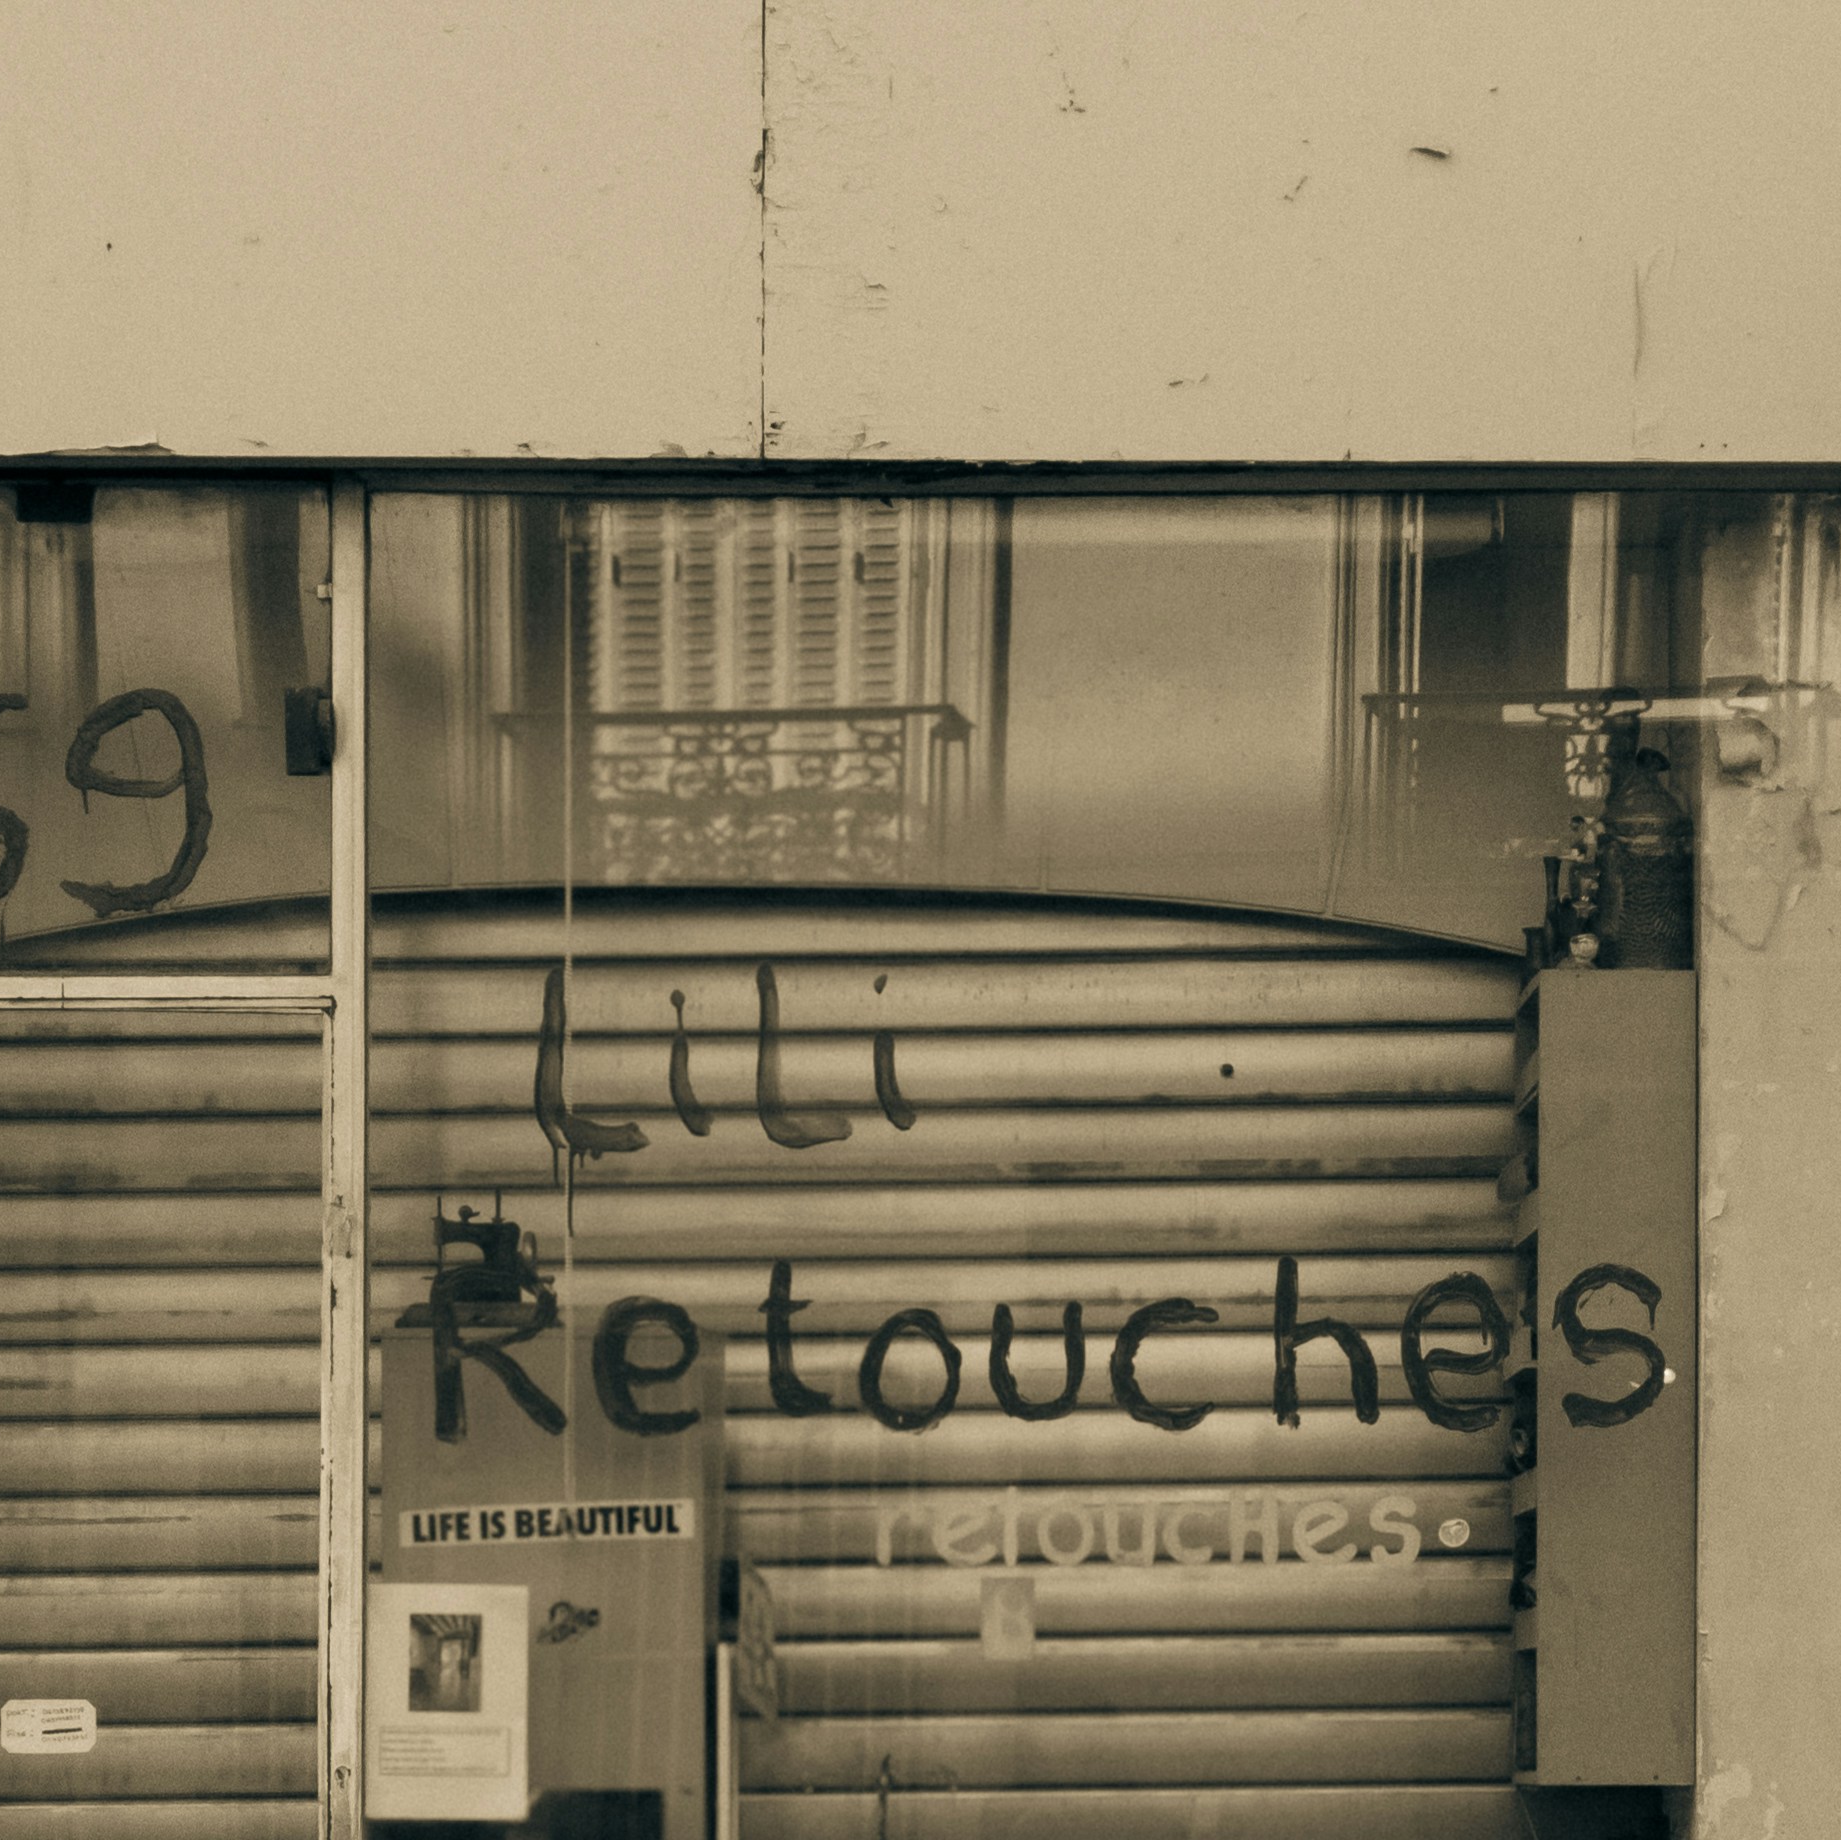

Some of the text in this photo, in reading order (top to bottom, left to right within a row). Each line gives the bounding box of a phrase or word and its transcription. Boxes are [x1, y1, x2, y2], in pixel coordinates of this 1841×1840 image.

[429, 1256, 1666, 1443] Retouches
[412, 1504, 680, 1543] LIFE IS BEAUTIFUL
